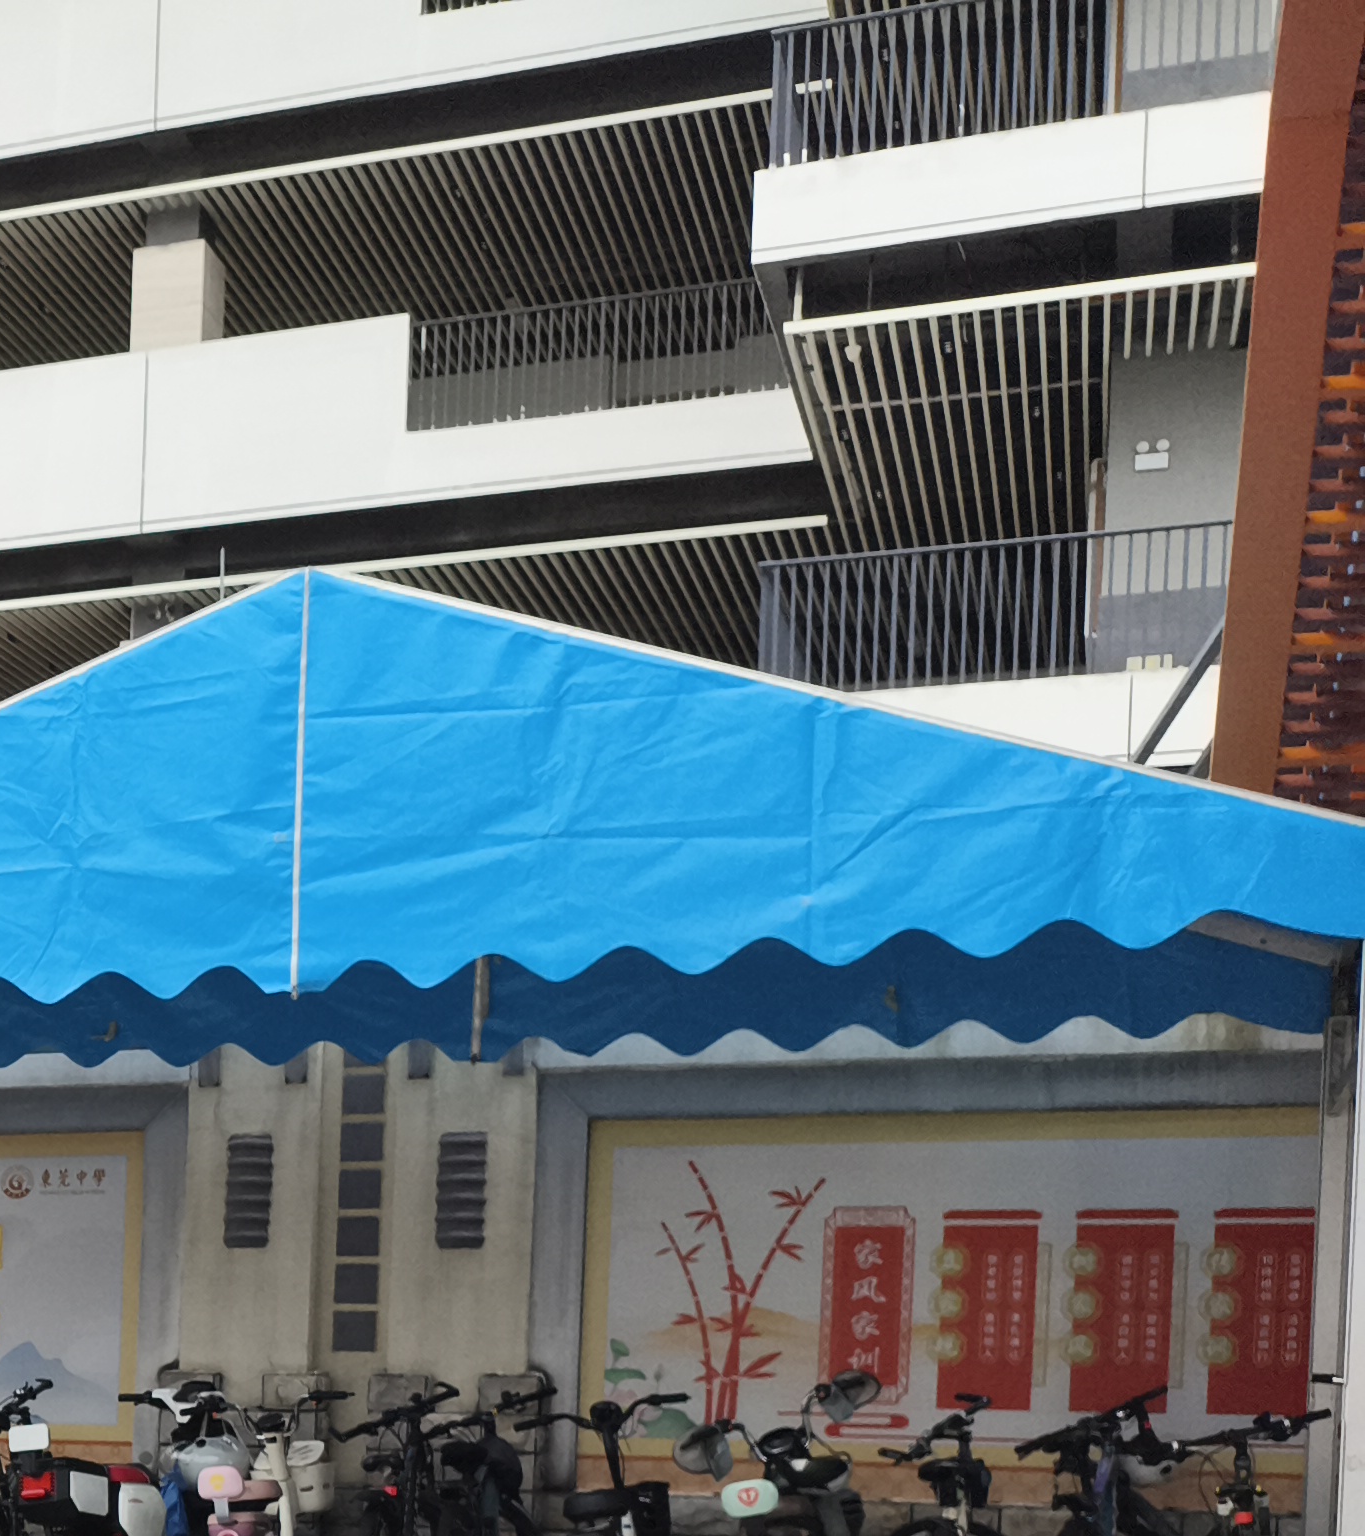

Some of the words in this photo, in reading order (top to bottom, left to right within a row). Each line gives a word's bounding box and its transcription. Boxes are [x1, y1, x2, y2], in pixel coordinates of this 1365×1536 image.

[40, 1168, 106, 1188] 東莞中學
[847, 1238, 886, 1374] 家风家训
